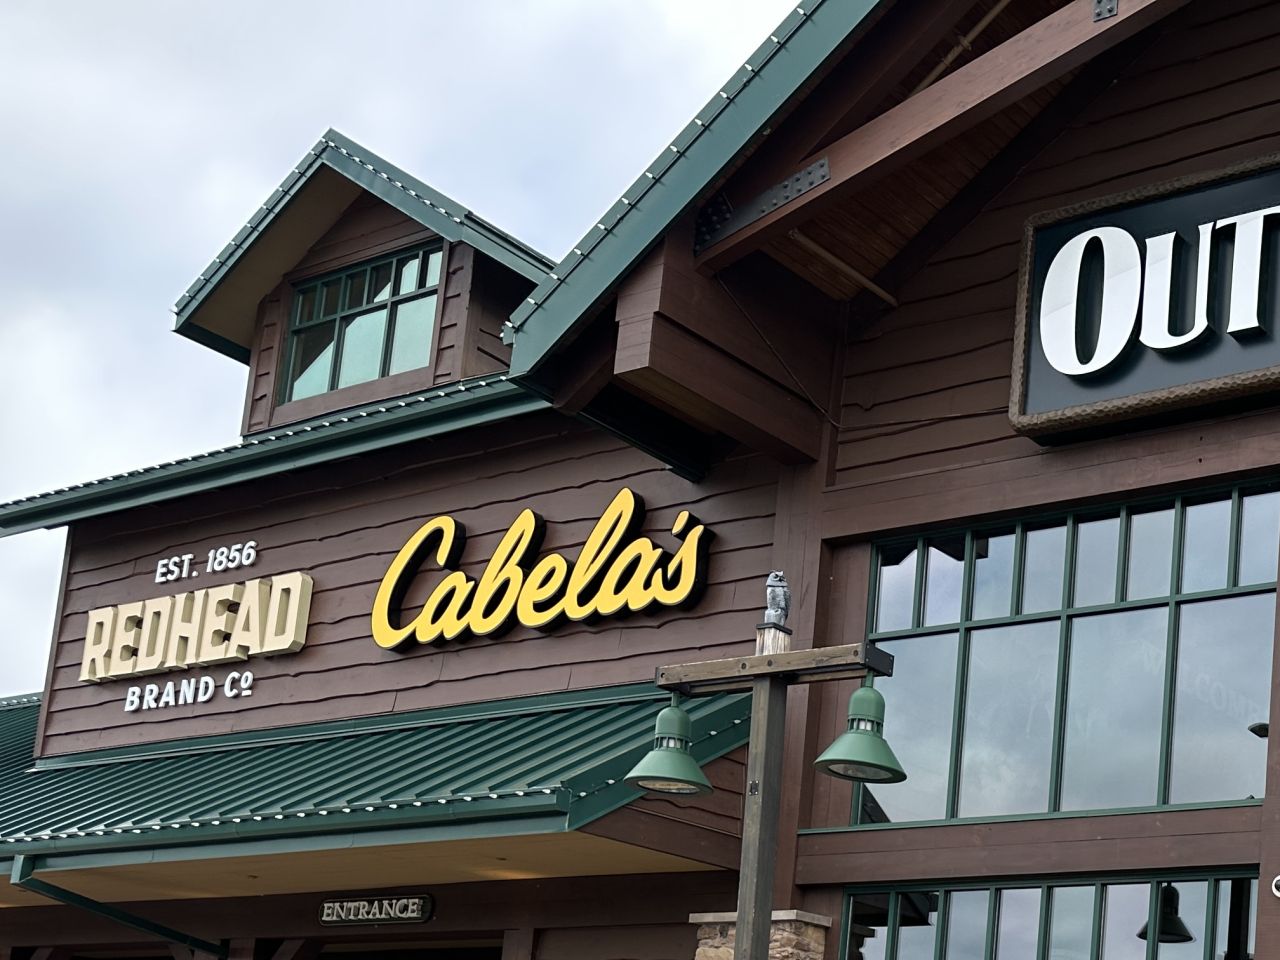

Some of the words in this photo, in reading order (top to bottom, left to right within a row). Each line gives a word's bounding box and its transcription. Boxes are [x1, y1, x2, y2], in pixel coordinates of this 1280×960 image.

[155, 553, 199, 583] EST.
[206, 541, 257, 573] 1856
[371, 487, 704, 649] Cabela's
[78, 571, 314, 682] REDHEAD
[124, 676, 215, 712] BRAND
[322, 899, 422, 920] ENTRANCE
